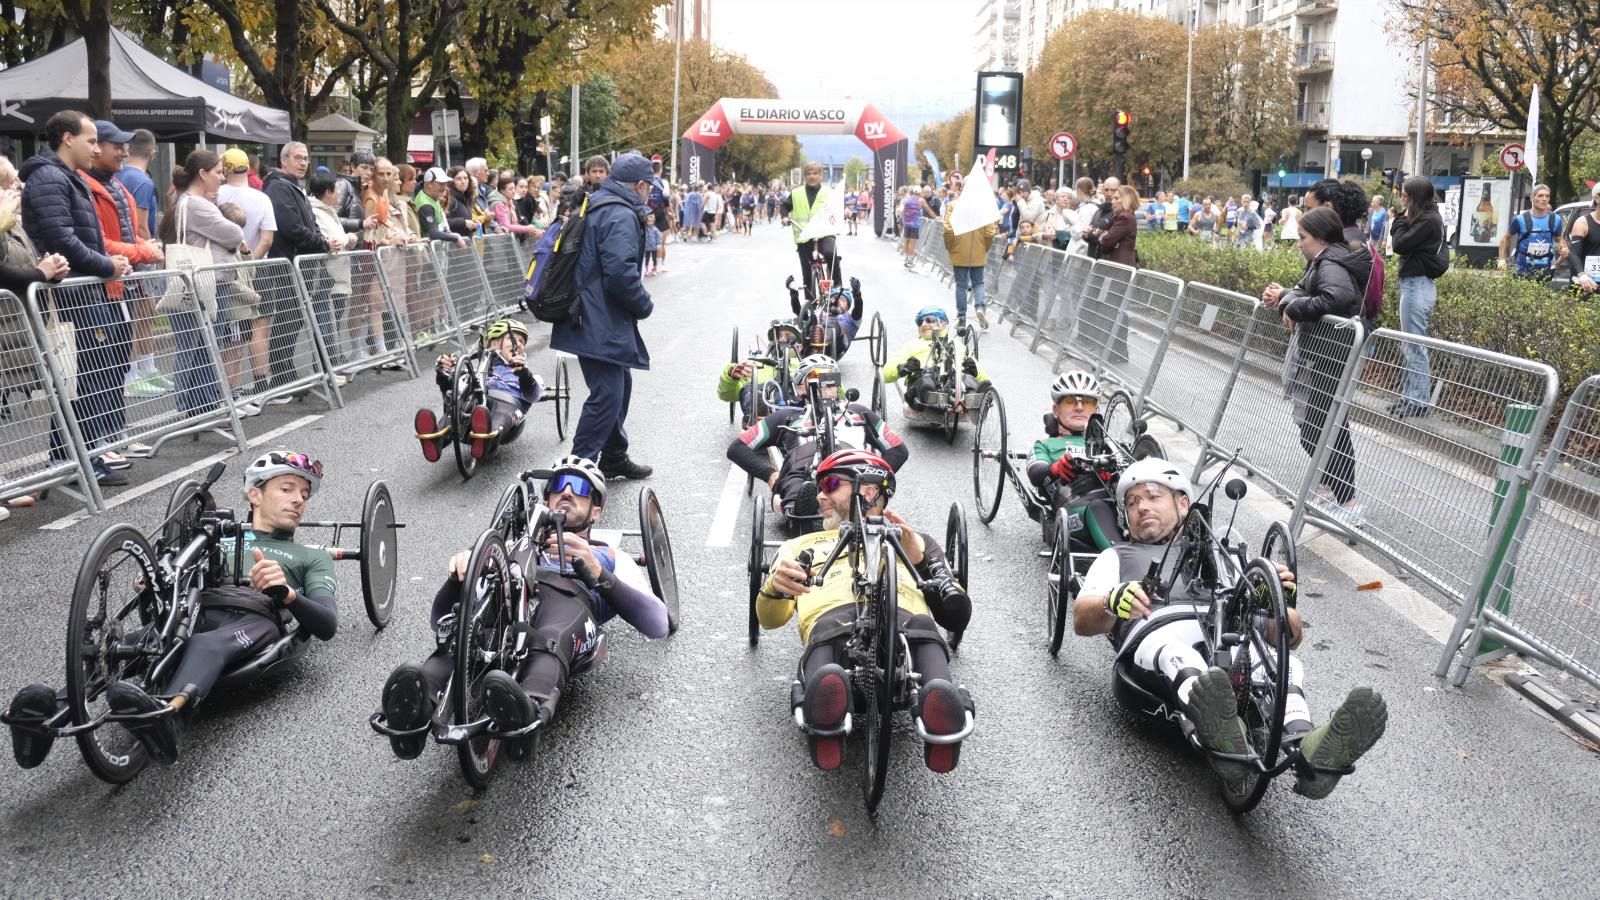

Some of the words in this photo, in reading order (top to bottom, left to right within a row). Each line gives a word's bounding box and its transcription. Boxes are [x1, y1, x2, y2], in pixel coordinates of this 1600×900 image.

[740, 107, 755, 119] EL
[757, 108, 800, 120] DIARIO
[803, 109, 845, 121] VASCO
[700, 120, 720, 132] DV
[864, 122, 885, 135] DV
[884, 159, 892, 188] VASCO
[121, 540, 165, 616] CORIMA
